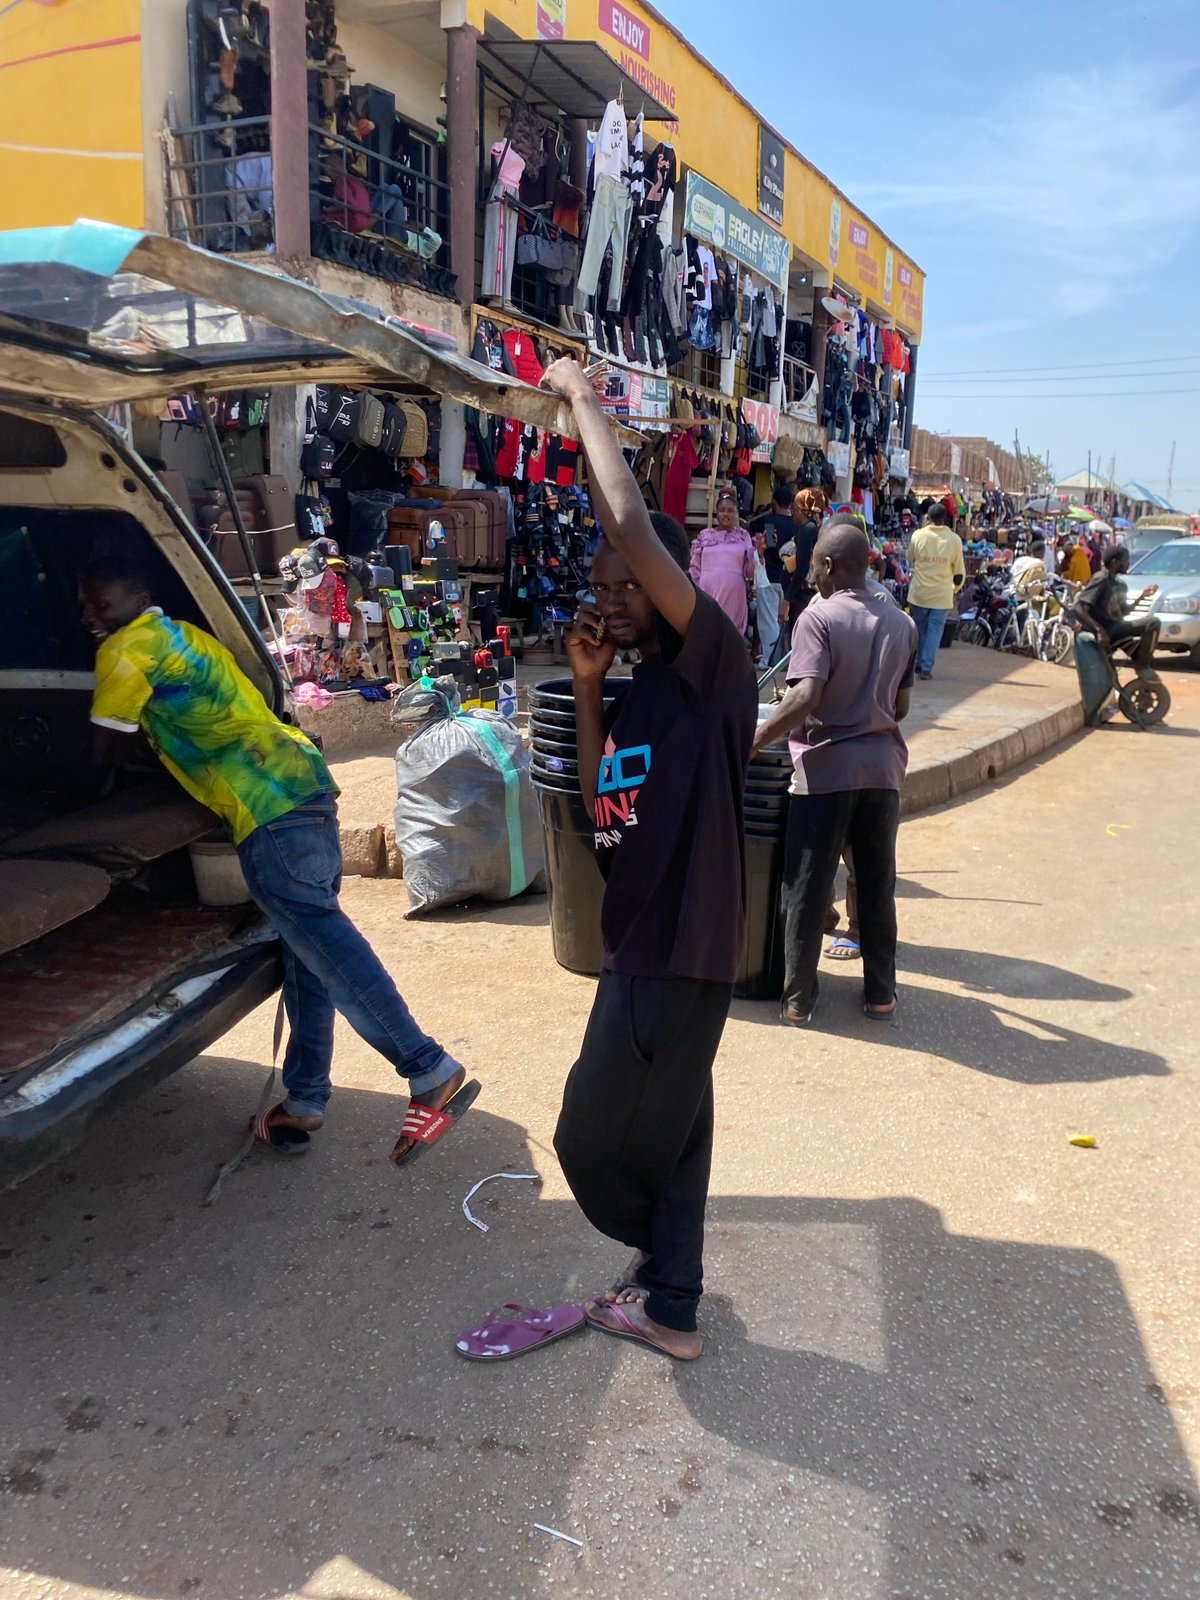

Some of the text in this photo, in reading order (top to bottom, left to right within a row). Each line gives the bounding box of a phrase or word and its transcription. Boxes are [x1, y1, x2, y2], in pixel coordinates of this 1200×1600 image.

[611, 7, 645, 53] ENJOY
[620, 52, 677, 110] NOURISHING
[727, 236, 758, 263] COLLECTIONS
[743, 400, 779, 444] POS
